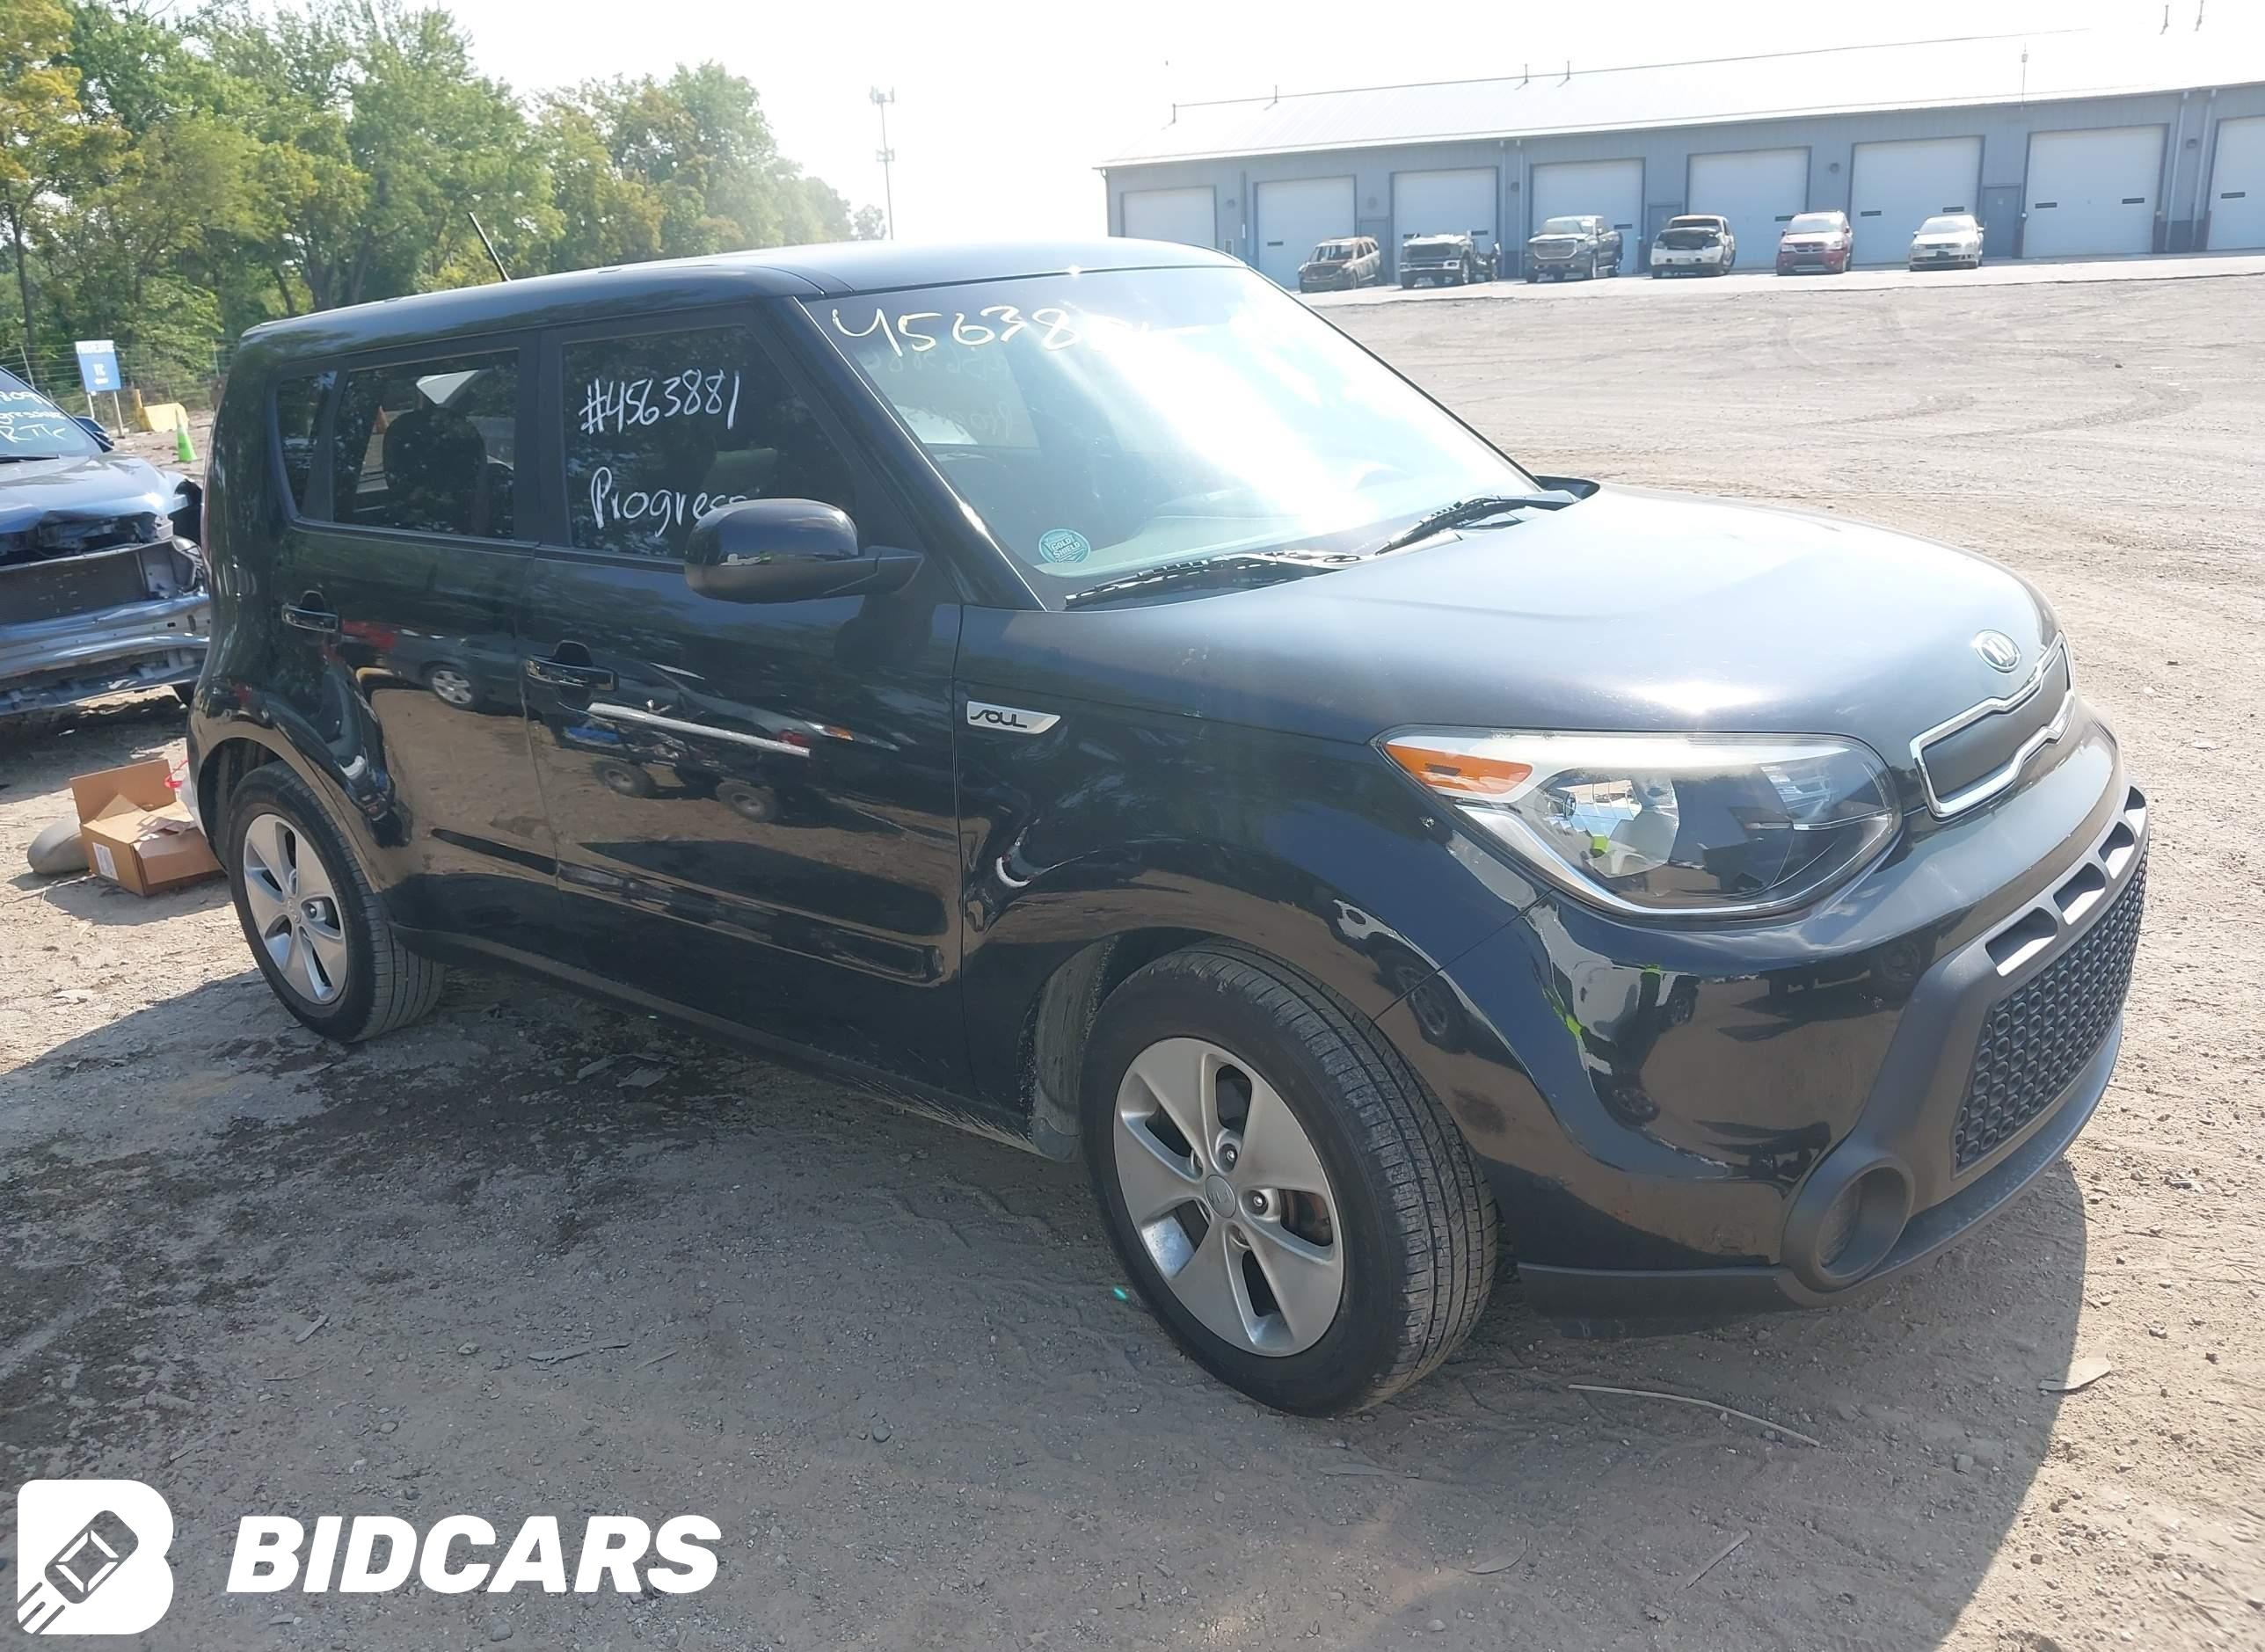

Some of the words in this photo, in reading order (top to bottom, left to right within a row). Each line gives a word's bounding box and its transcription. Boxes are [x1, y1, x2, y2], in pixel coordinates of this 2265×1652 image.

[579, 368, 740, 434] #4563881
[1051, 537, 1072, 551] GOLD
[1053, 541, 1081, 559] SHIELD
[970, 709, 1027, 728] SOUL
